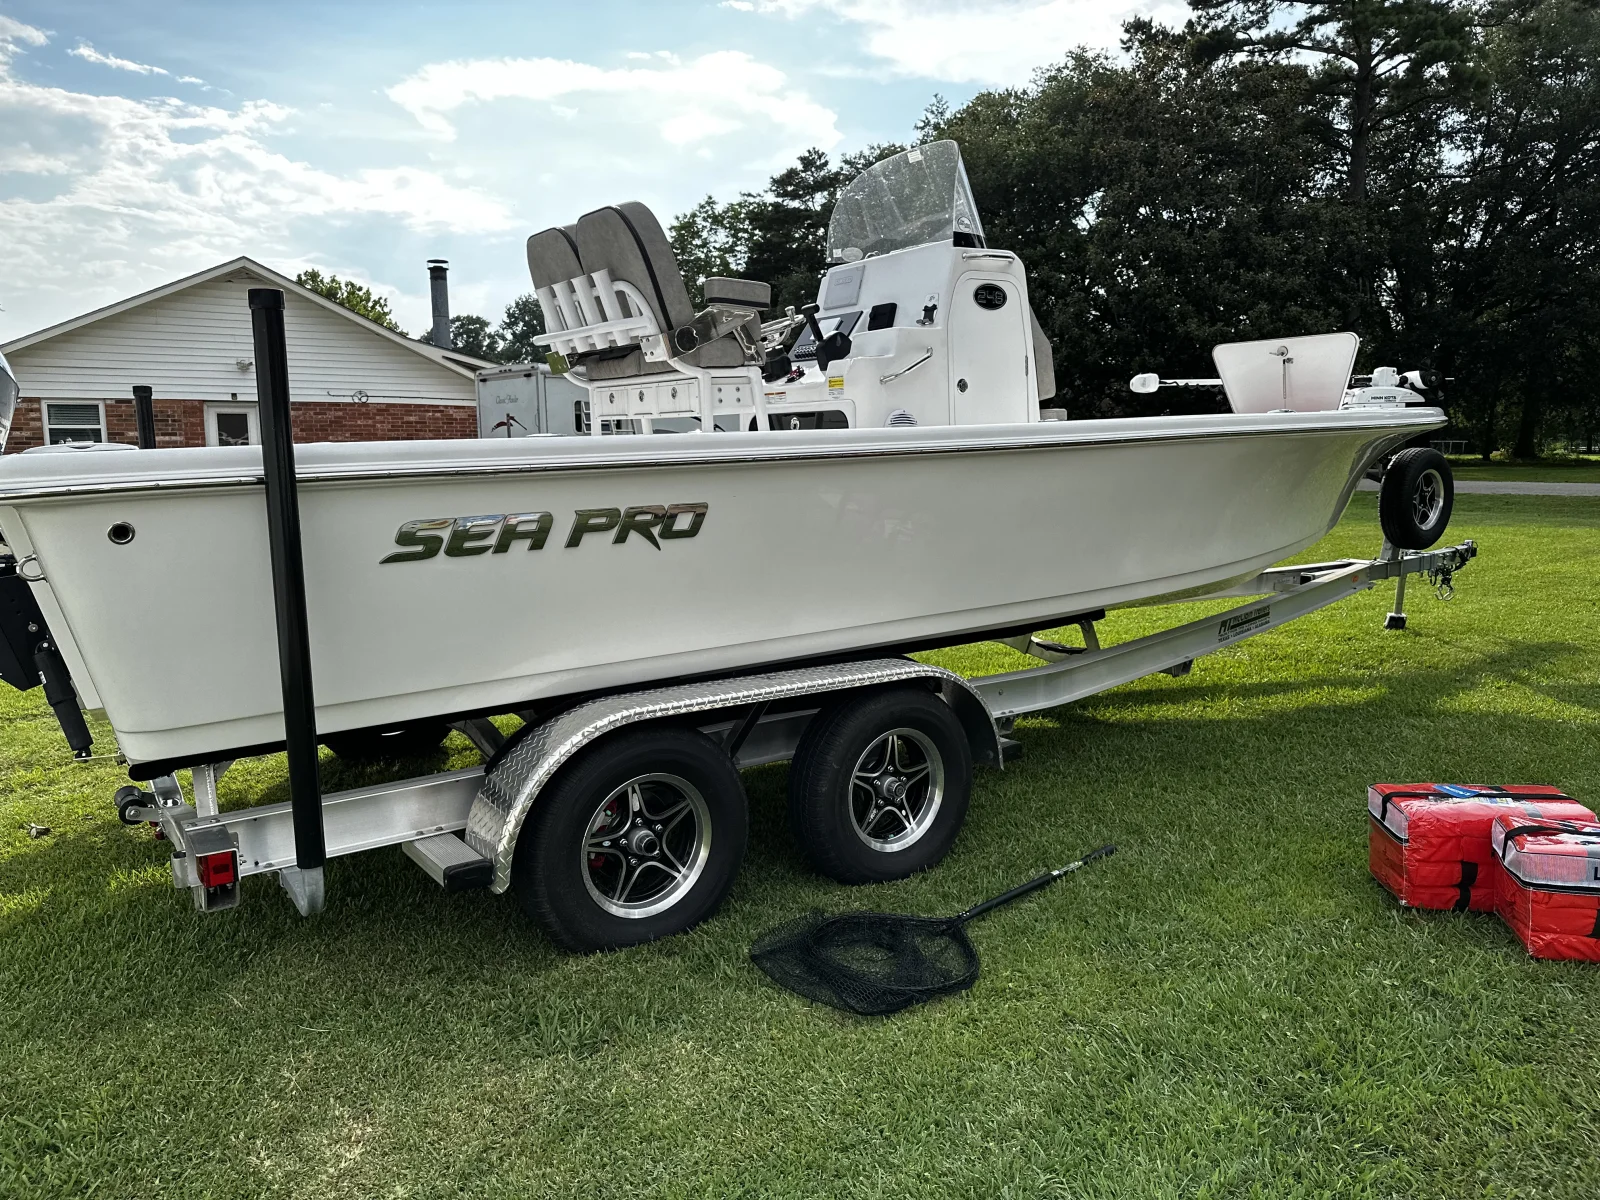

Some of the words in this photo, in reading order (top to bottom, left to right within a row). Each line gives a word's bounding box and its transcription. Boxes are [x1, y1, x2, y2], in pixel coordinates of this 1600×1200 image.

[977, 289, 1004, 304] 248
[379, 511, 554, 564] SEA
[564, 502, 708, 551] PRO
